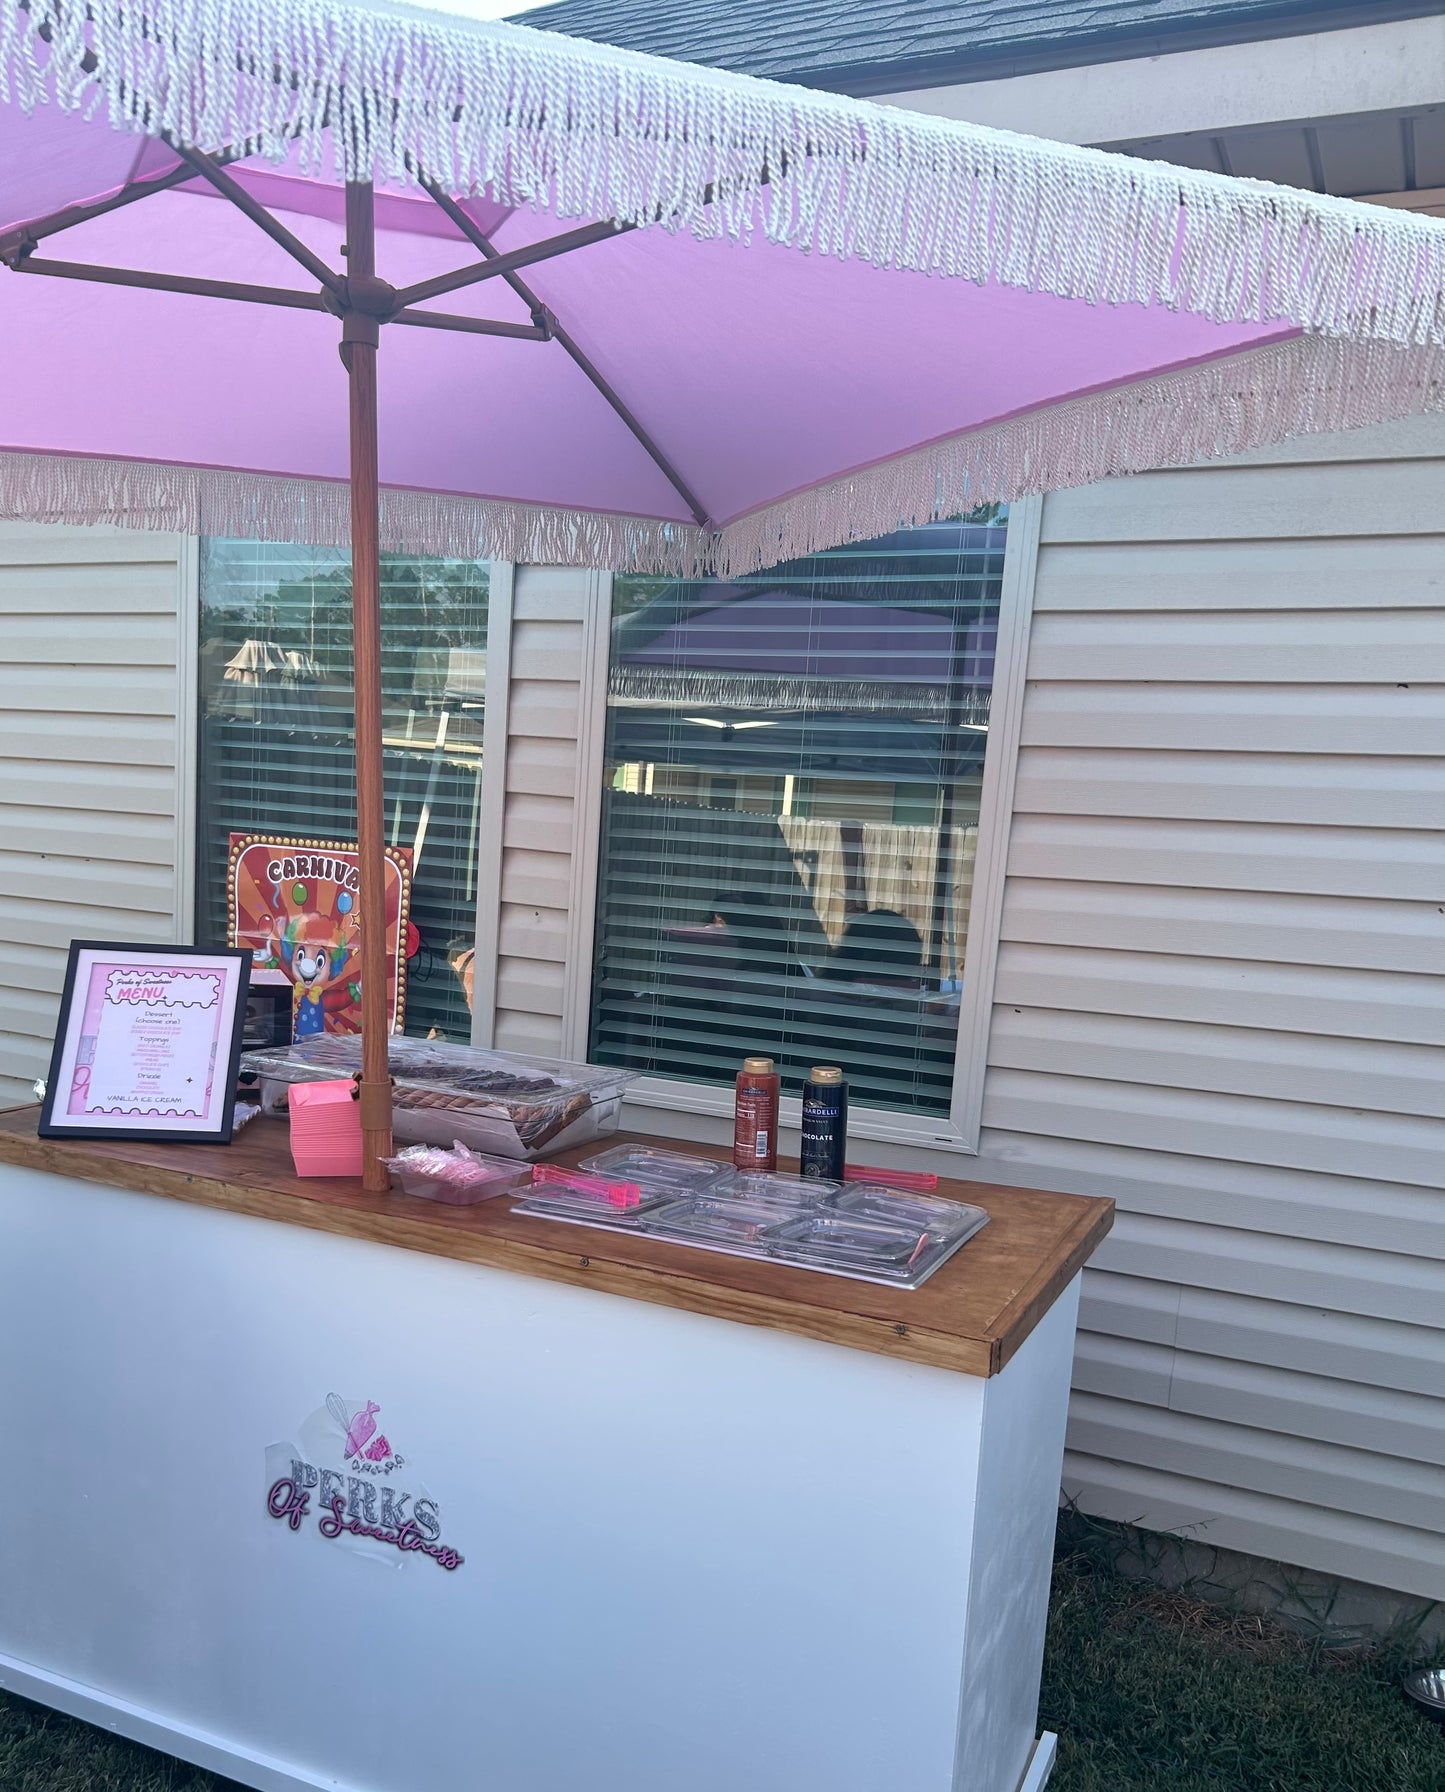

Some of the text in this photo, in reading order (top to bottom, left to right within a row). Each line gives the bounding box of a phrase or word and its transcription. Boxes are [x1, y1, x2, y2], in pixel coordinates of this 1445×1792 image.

[267, 855, 359, 889] CARNIVA
[117, 987, 164, 999] MENU
[139, 1036, 169, 1045] Toppings
[803, 1107, 837, 1116] RARDELLI
[291, 1459, 441, 1542] PERKS
[268, 1478, 464, 1570] Of Sweetness
